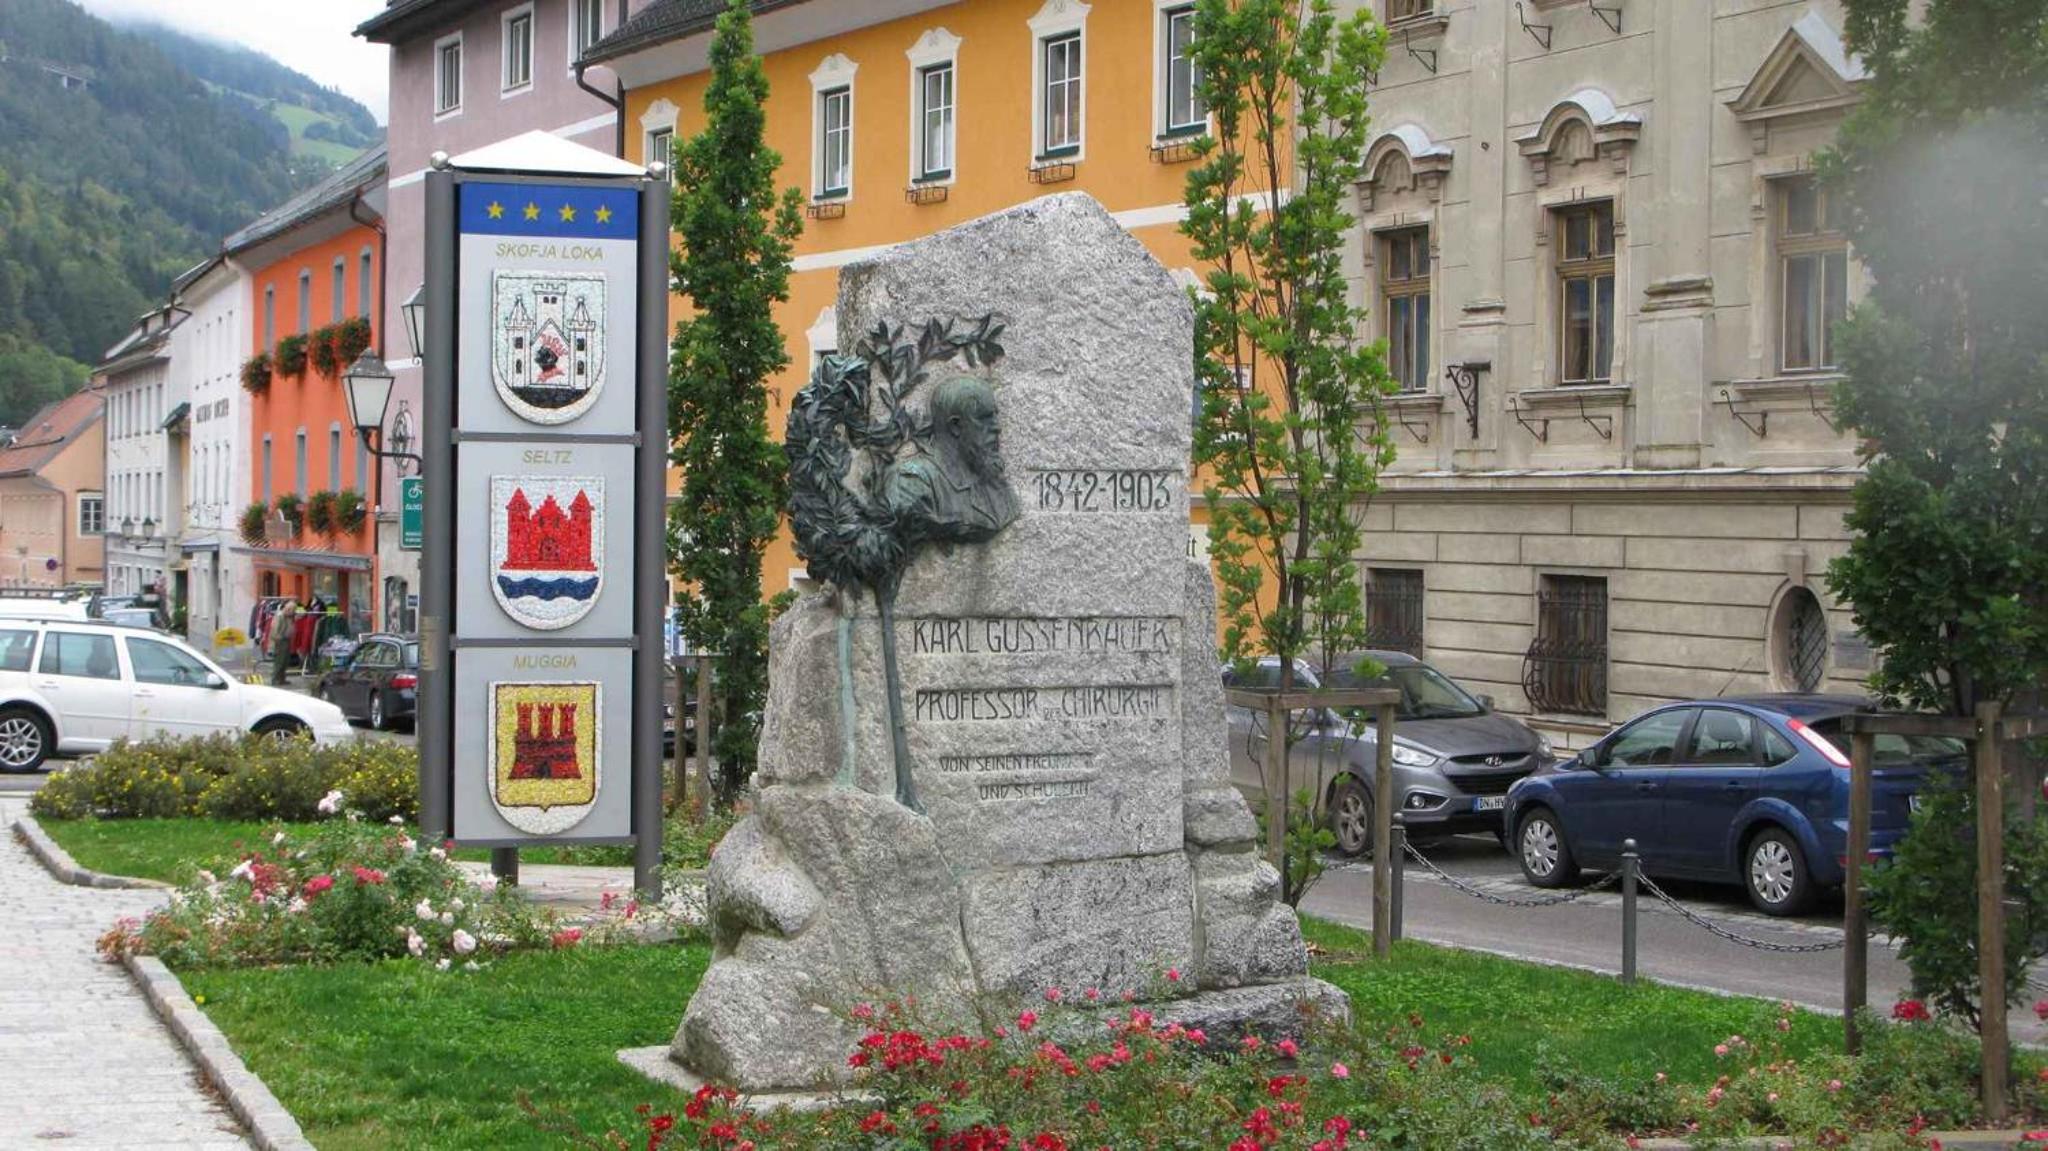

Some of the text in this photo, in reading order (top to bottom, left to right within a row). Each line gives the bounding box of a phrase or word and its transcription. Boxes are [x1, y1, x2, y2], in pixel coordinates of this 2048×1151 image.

[562, 245, 604, 260] LOKA
[522, 450, 572, 464] SELTZ
[1032, 471, 1171, 512] 1842-1903
[914, 619, 977, 653] KARL
[513, 655, 577, 670] MUGGIA
[916, 689, 1038, 721] PROFESSOR
[1062, 687, 1160, 717] CHIRURGIE
[940, 756, 969, 772] VON
[975, 755, 1023, 772] SEINEN
[980, 785, 1009, 801] UND
